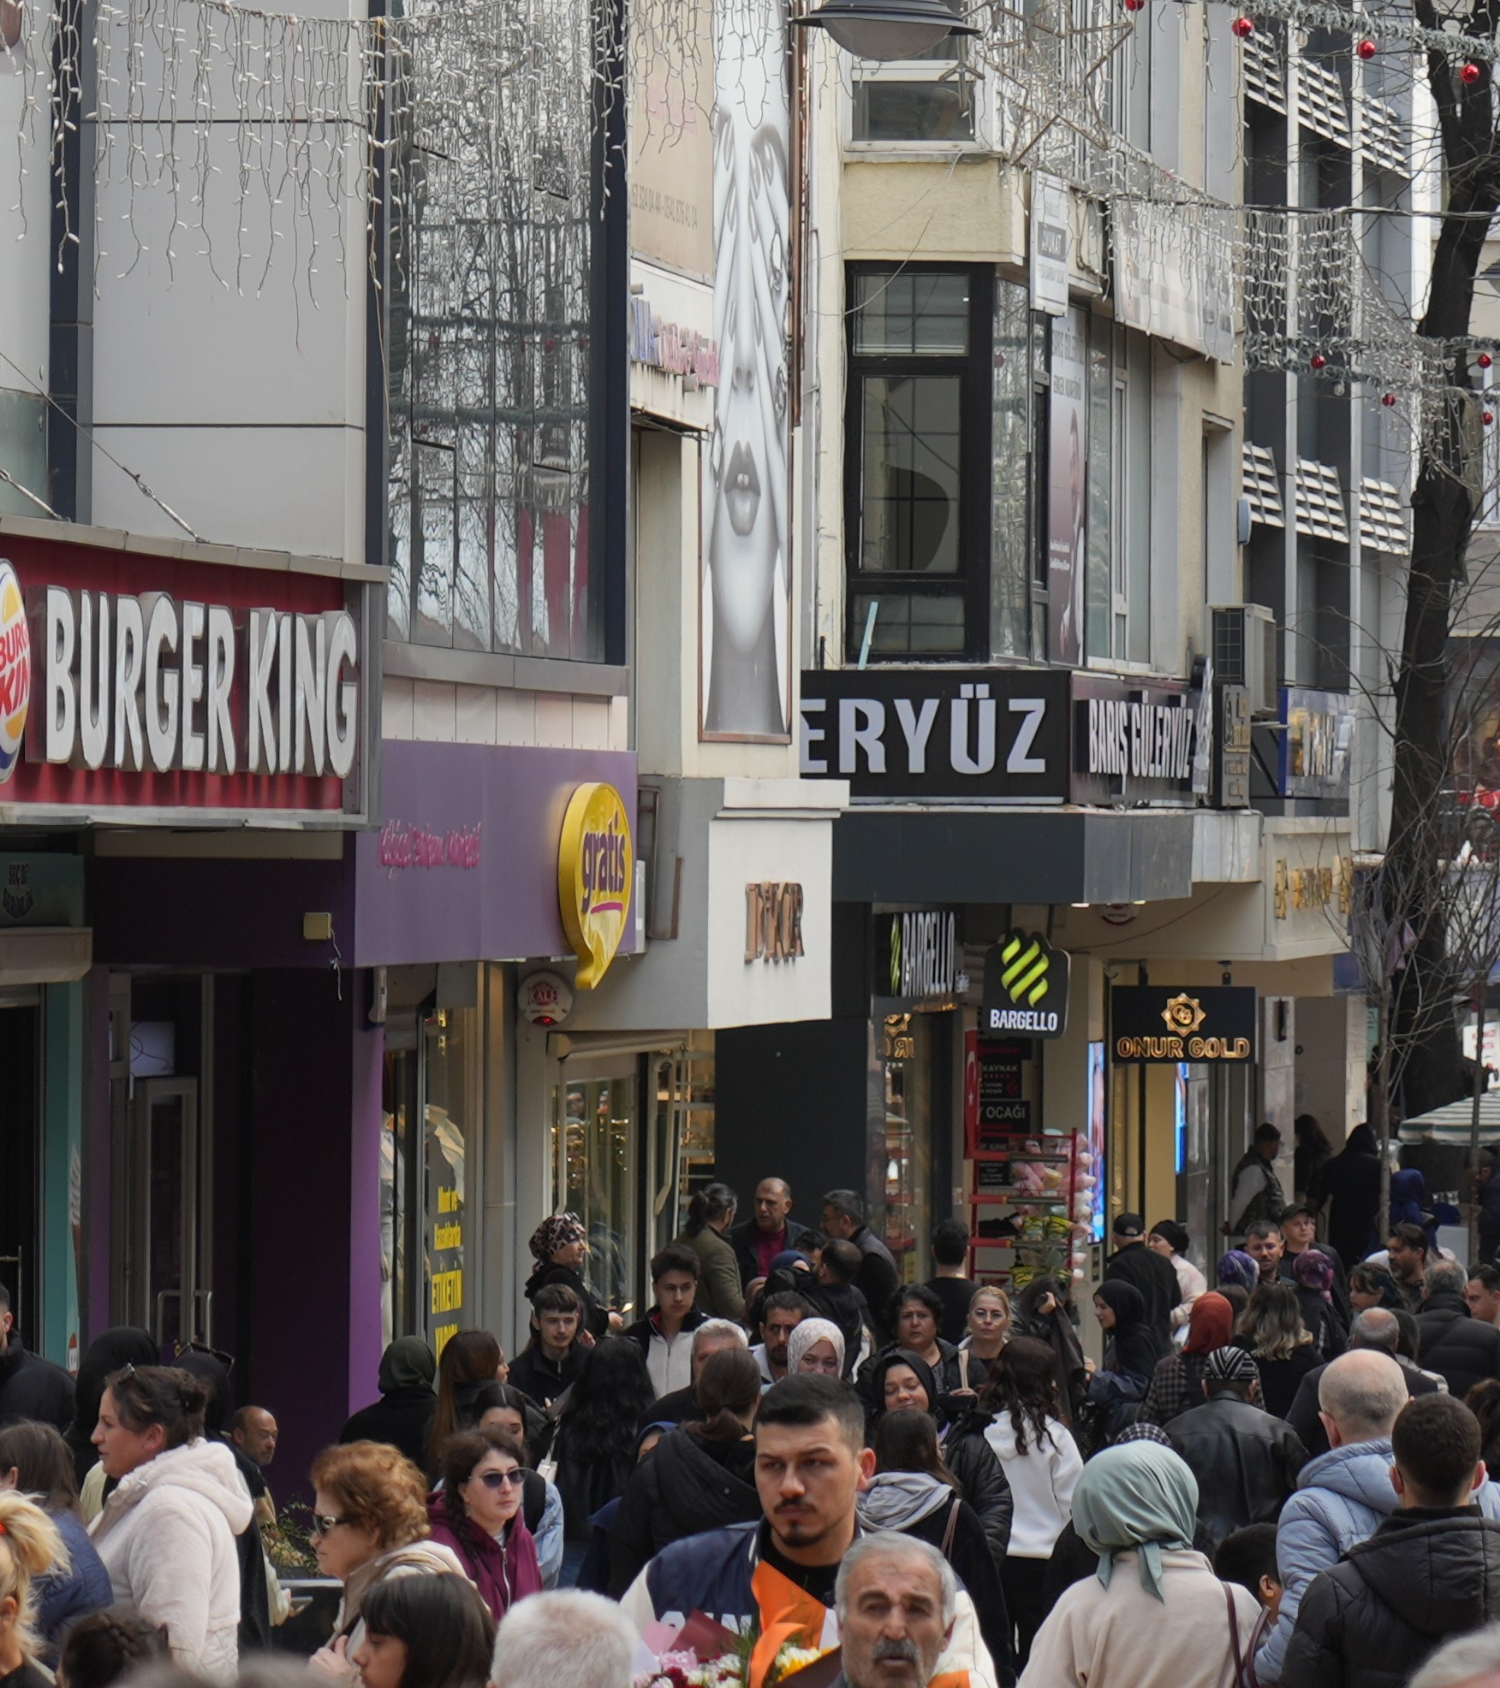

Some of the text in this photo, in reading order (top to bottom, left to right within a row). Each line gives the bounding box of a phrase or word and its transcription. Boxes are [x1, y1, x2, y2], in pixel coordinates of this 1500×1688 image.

[46, 585, 359, 779] BURGER KING
[800, 683, 1047, 775] ERYÜZ
[1088, 698, 1128, 796] BARIŞ
[1131, 689, 1194, 780] GÜLERYÜZ
[581, 809, 627, 915] gratis
[901, 911, 956, 998] BARGELLO
[989, 1009, 1059, 1032] BARGELLO
[1116, 1037, 1250, 1059] ONUR GOLD
[986, 1104, 1026, 1119] OCAĞI
